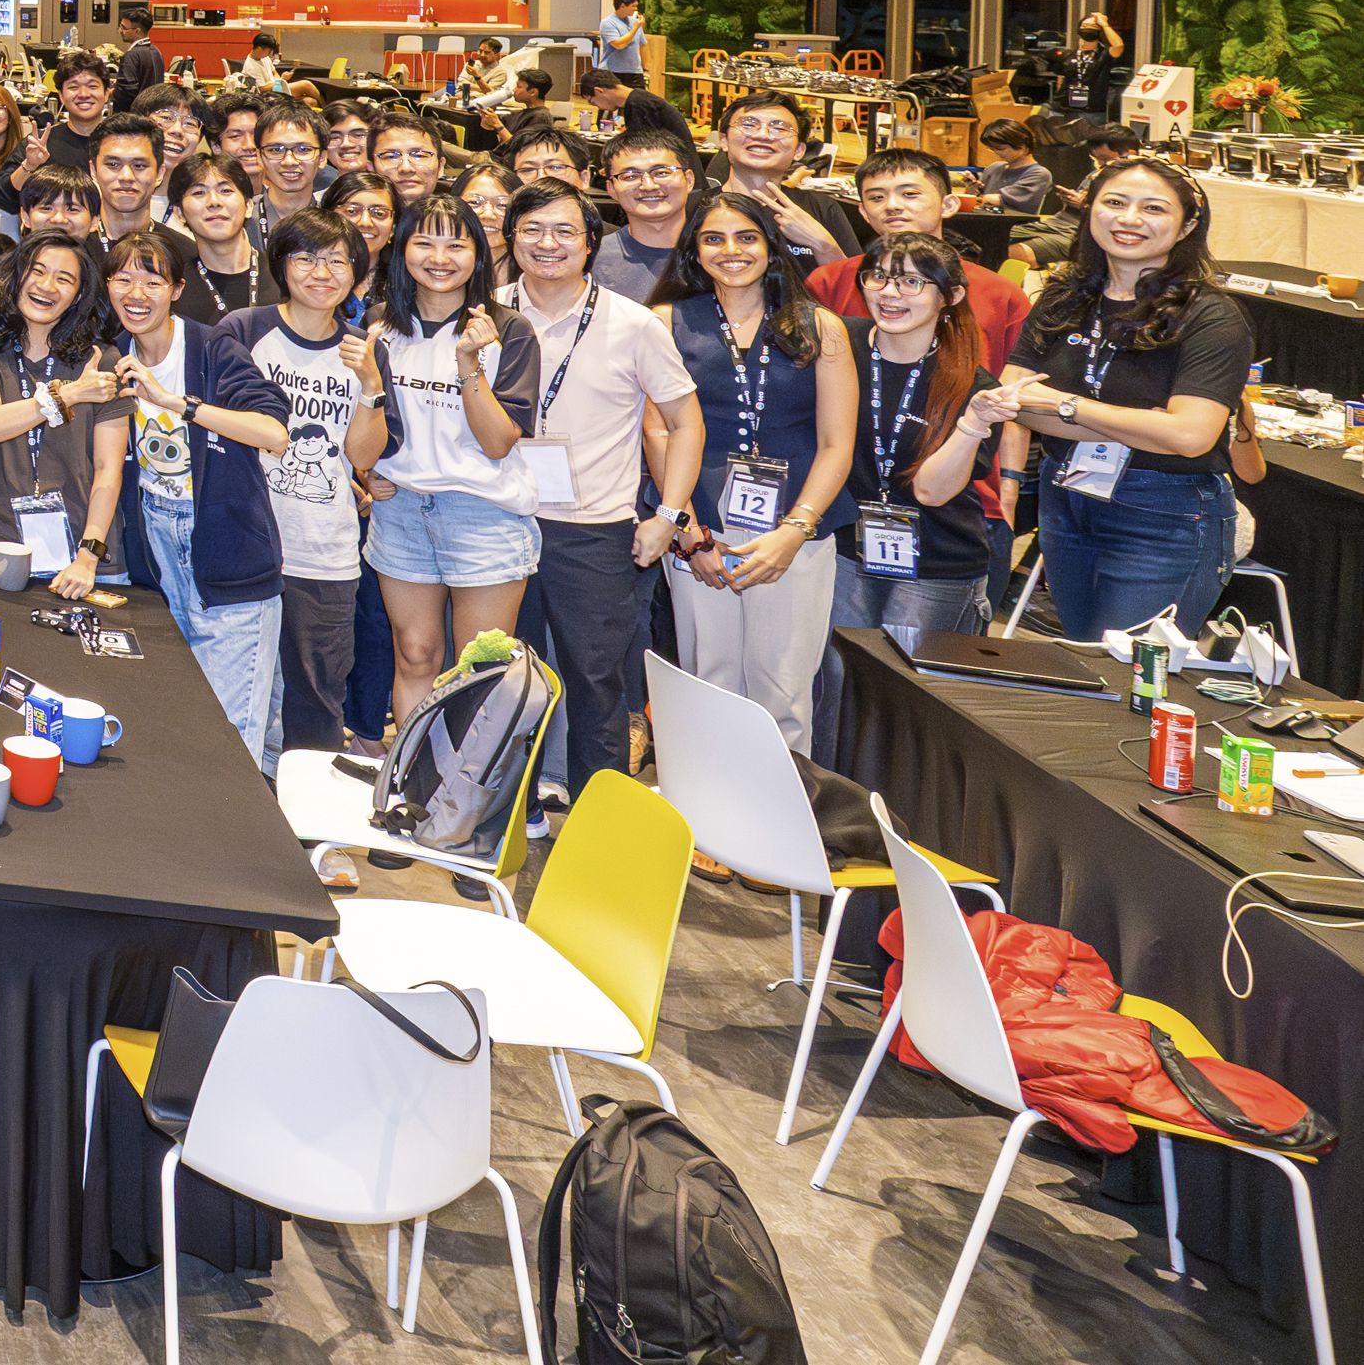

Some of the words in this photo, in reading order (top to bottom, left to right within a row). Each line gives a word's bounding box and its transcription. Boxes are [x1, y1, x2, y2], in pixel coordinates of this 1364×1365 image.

[268, 363, 308, 391] You're
[313, 380, 322, 393] a
[327, 376, 353, 400] Pal,
[290, 392, 350, 425] OOPY!
[425, 399, 460, 410] RACING
[740, 486, 769, 496] GROUP
[740, 494, 766, 515] 12
[727, 516, 772, 529] PARTICIPANT
[874, 533, 904, 542] GROUP
[878, 541, 899, 560] 11
[867, 564, 914, 575] PARTICIPANT
[35, 722, 47, 734] TEA
